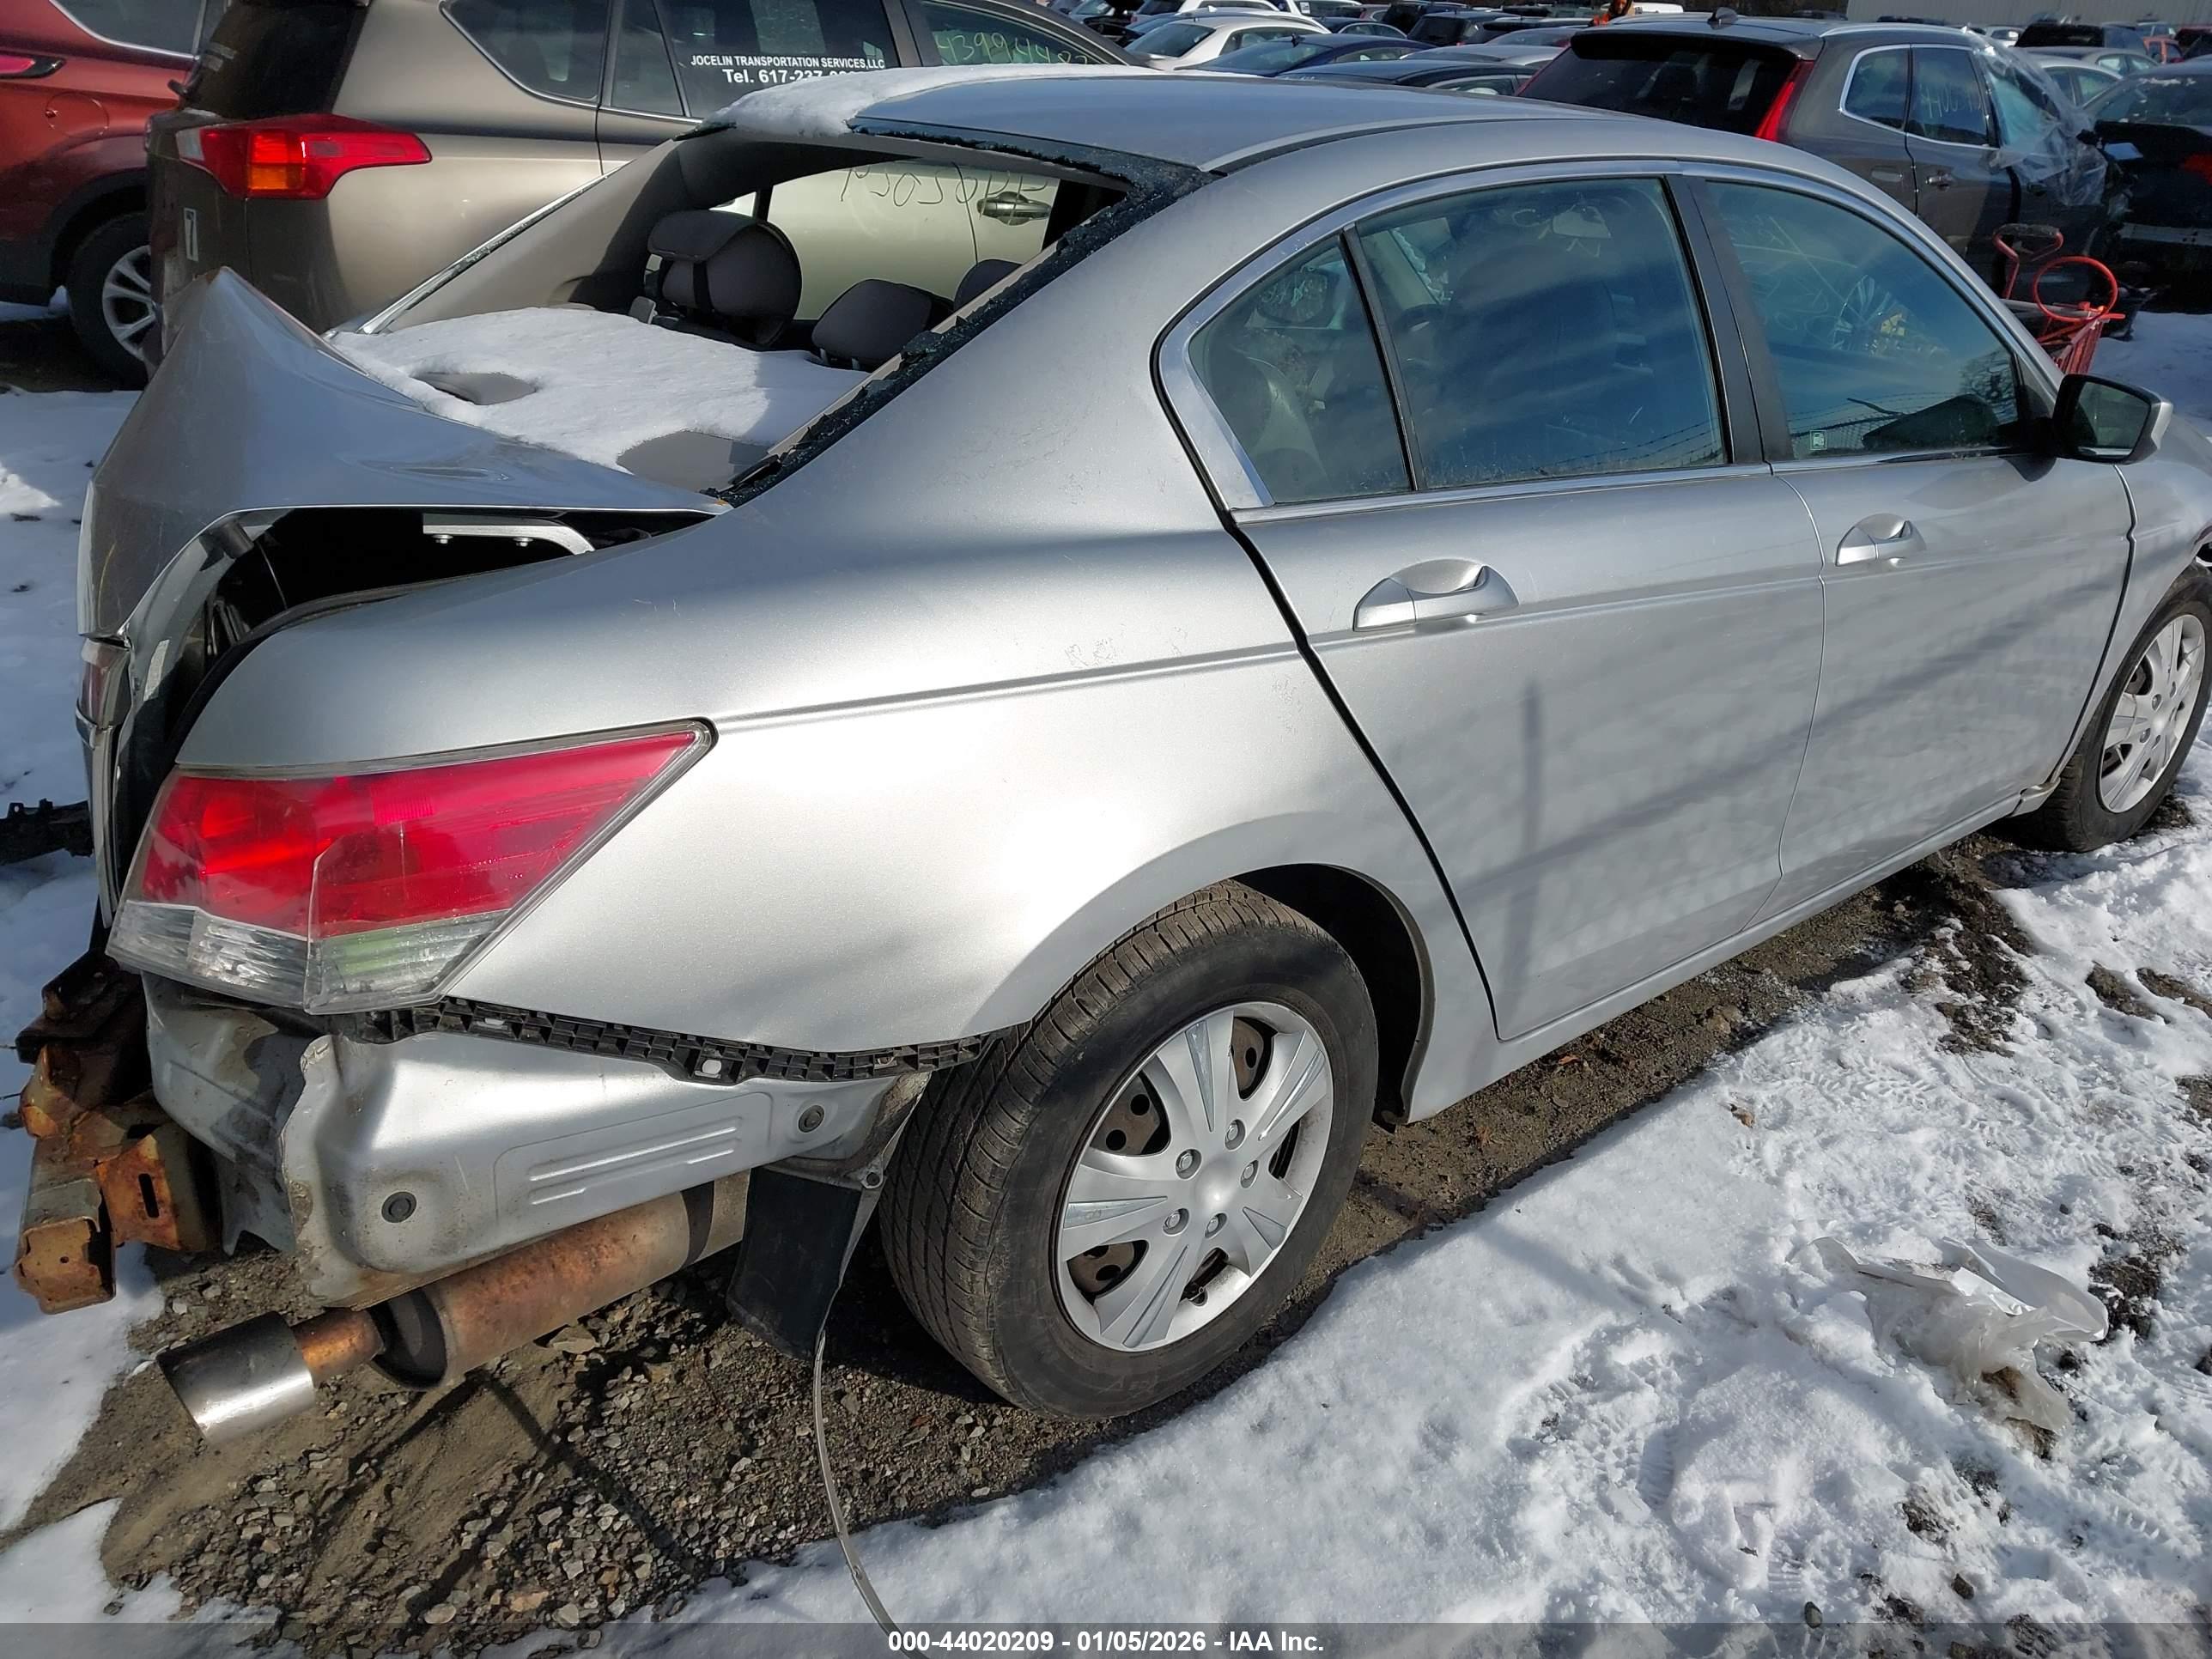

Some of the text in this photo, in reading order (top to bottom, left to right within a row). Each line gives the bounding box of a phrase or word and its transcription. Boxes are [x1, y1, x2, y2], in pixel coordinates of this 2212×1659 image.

[690, 55, 733, 66] JOCELIN
[733, 56, 820, 68] TRANSPORTATION
[722, 69, 755, 83] Tel.
